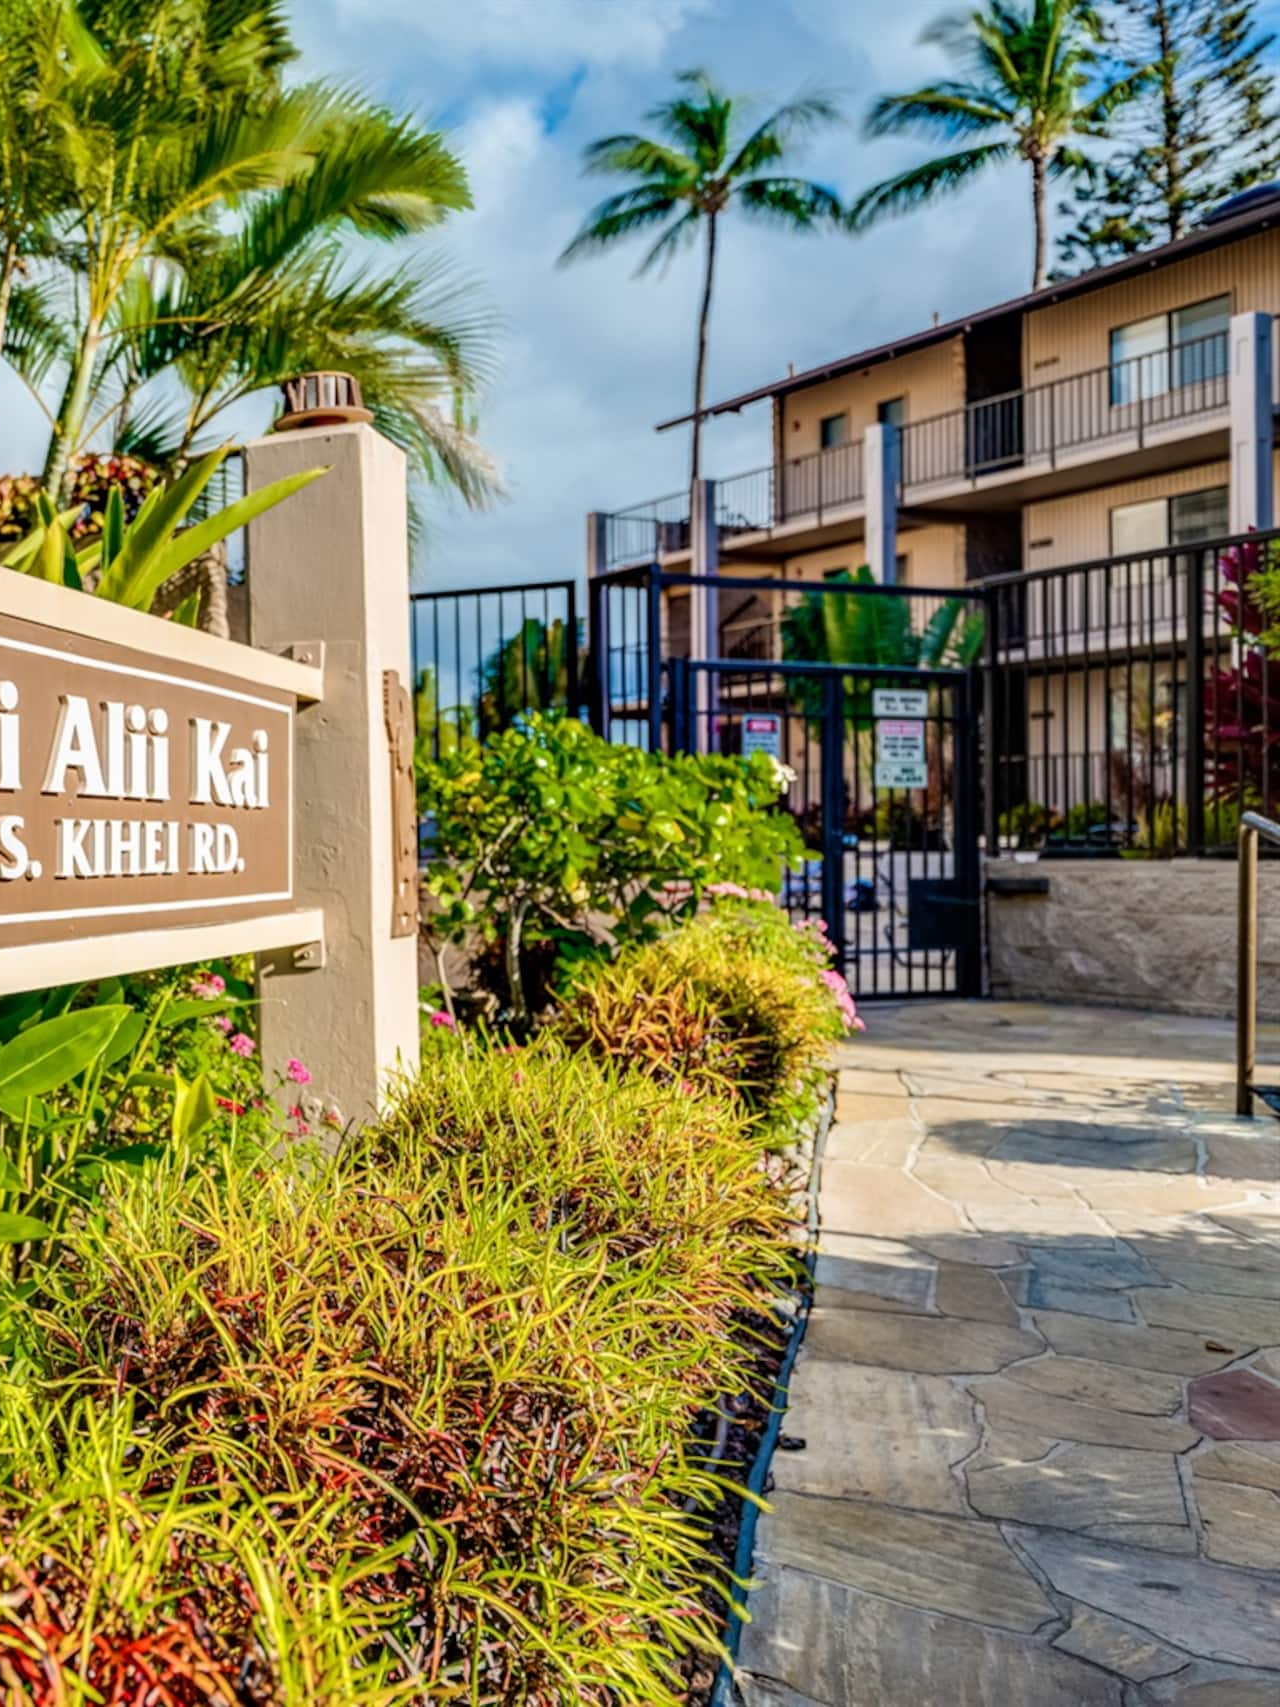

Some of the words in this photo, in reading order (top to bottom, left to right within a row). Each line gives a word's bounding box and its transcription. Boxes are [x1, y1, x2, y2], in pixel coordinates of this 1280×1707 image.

[41, 694, 170, 801] Alii
[188, 717, 270, 809] Kai
[55, 818, 180, 879] KIHEI
[187, 822, 246, 877] RD.
